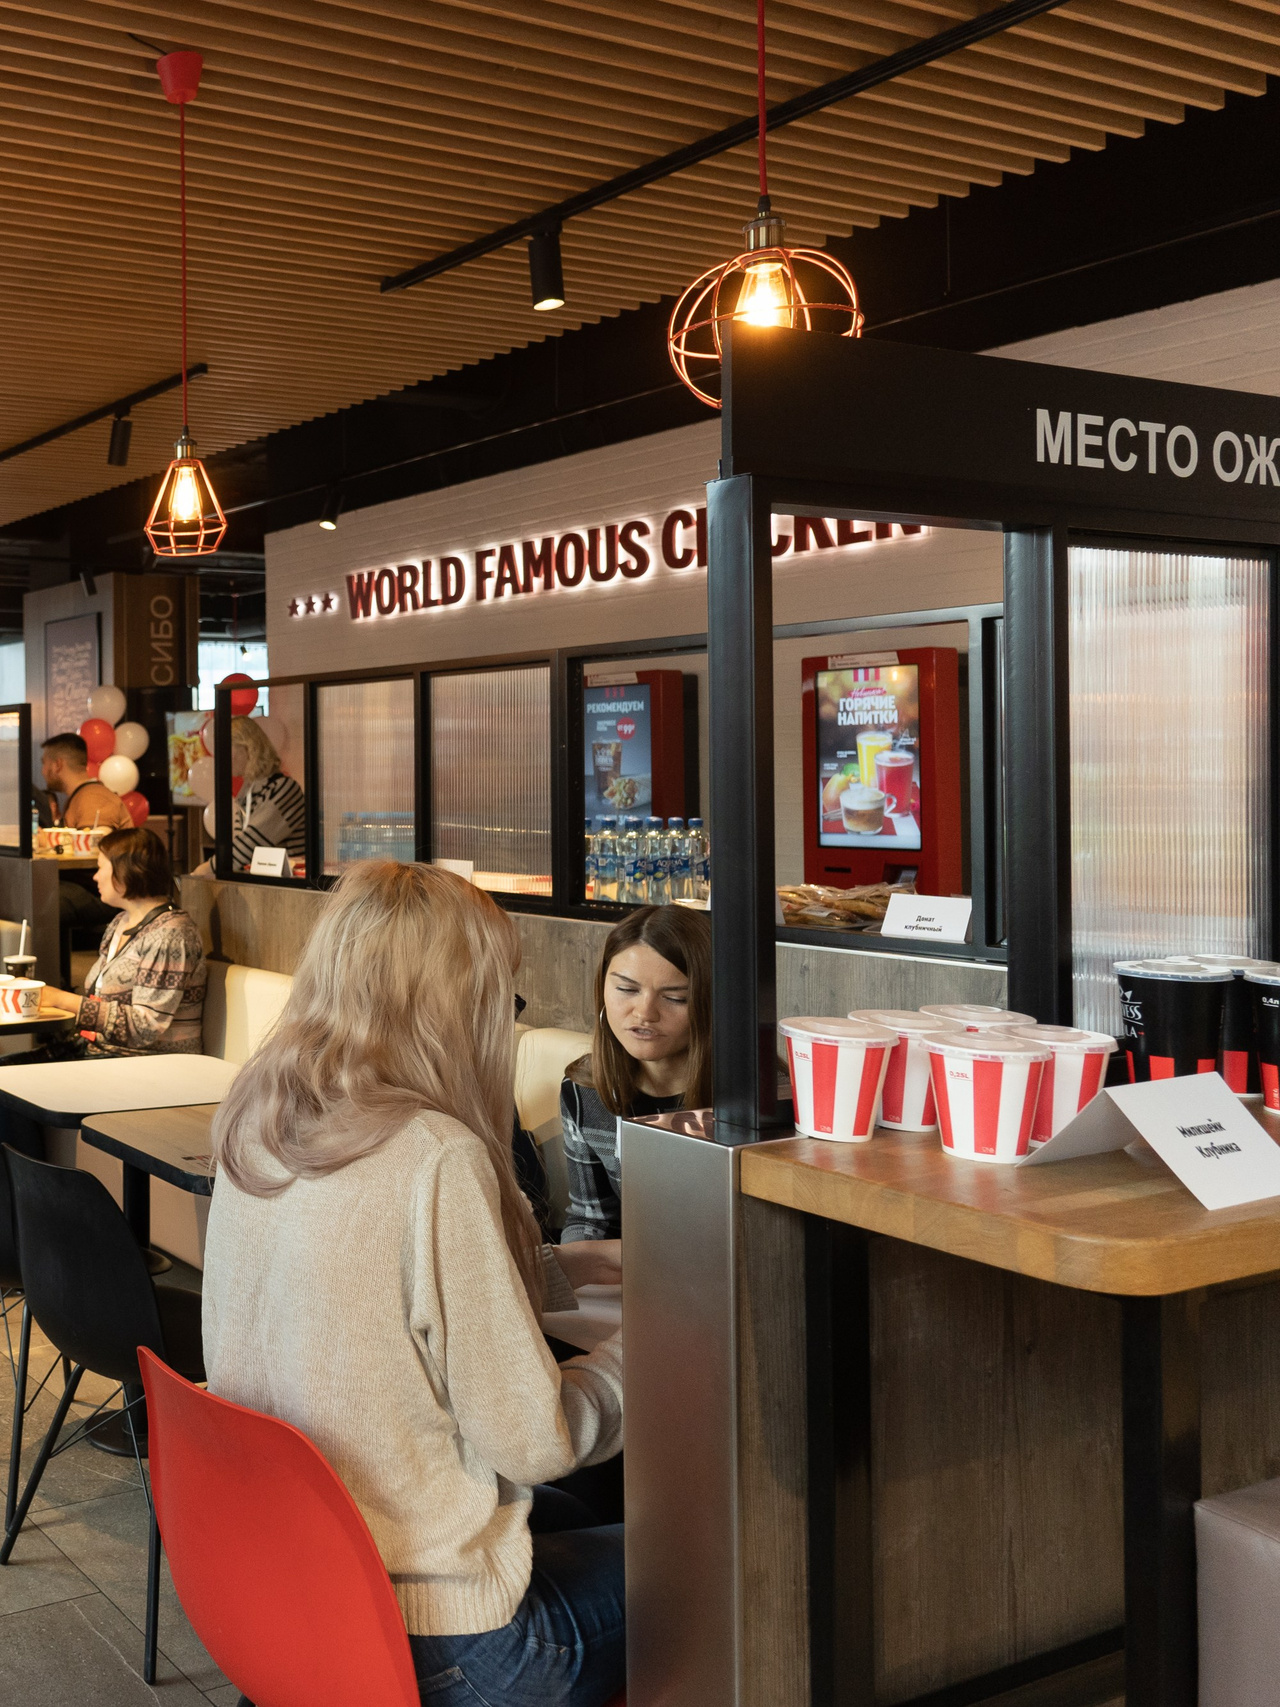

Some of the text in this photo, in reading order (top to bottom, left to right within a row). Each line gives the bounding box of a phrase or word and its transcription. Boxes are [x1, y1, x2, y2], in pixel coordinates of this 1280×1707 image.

[1036, 408, 1199, 478] МЕСТО
[346, 556, 466, 621] WORLD
[475, 520, 651, 602] FAMOUS
[586, 700, 645, 714] РЕКОМЕНДУЕМ
[839, 695, 896, 711] ГОРЯЧИЕ
[837, 710, 899, 726] НАПИТКИ
[904, 923, 943, 933] клубничный
[949, 1070, 970, 1079] 0,25L
[1176, 1118, 1227, 1138] Милкшейк
[1195, 1142, 1242, 1160] Клубника
